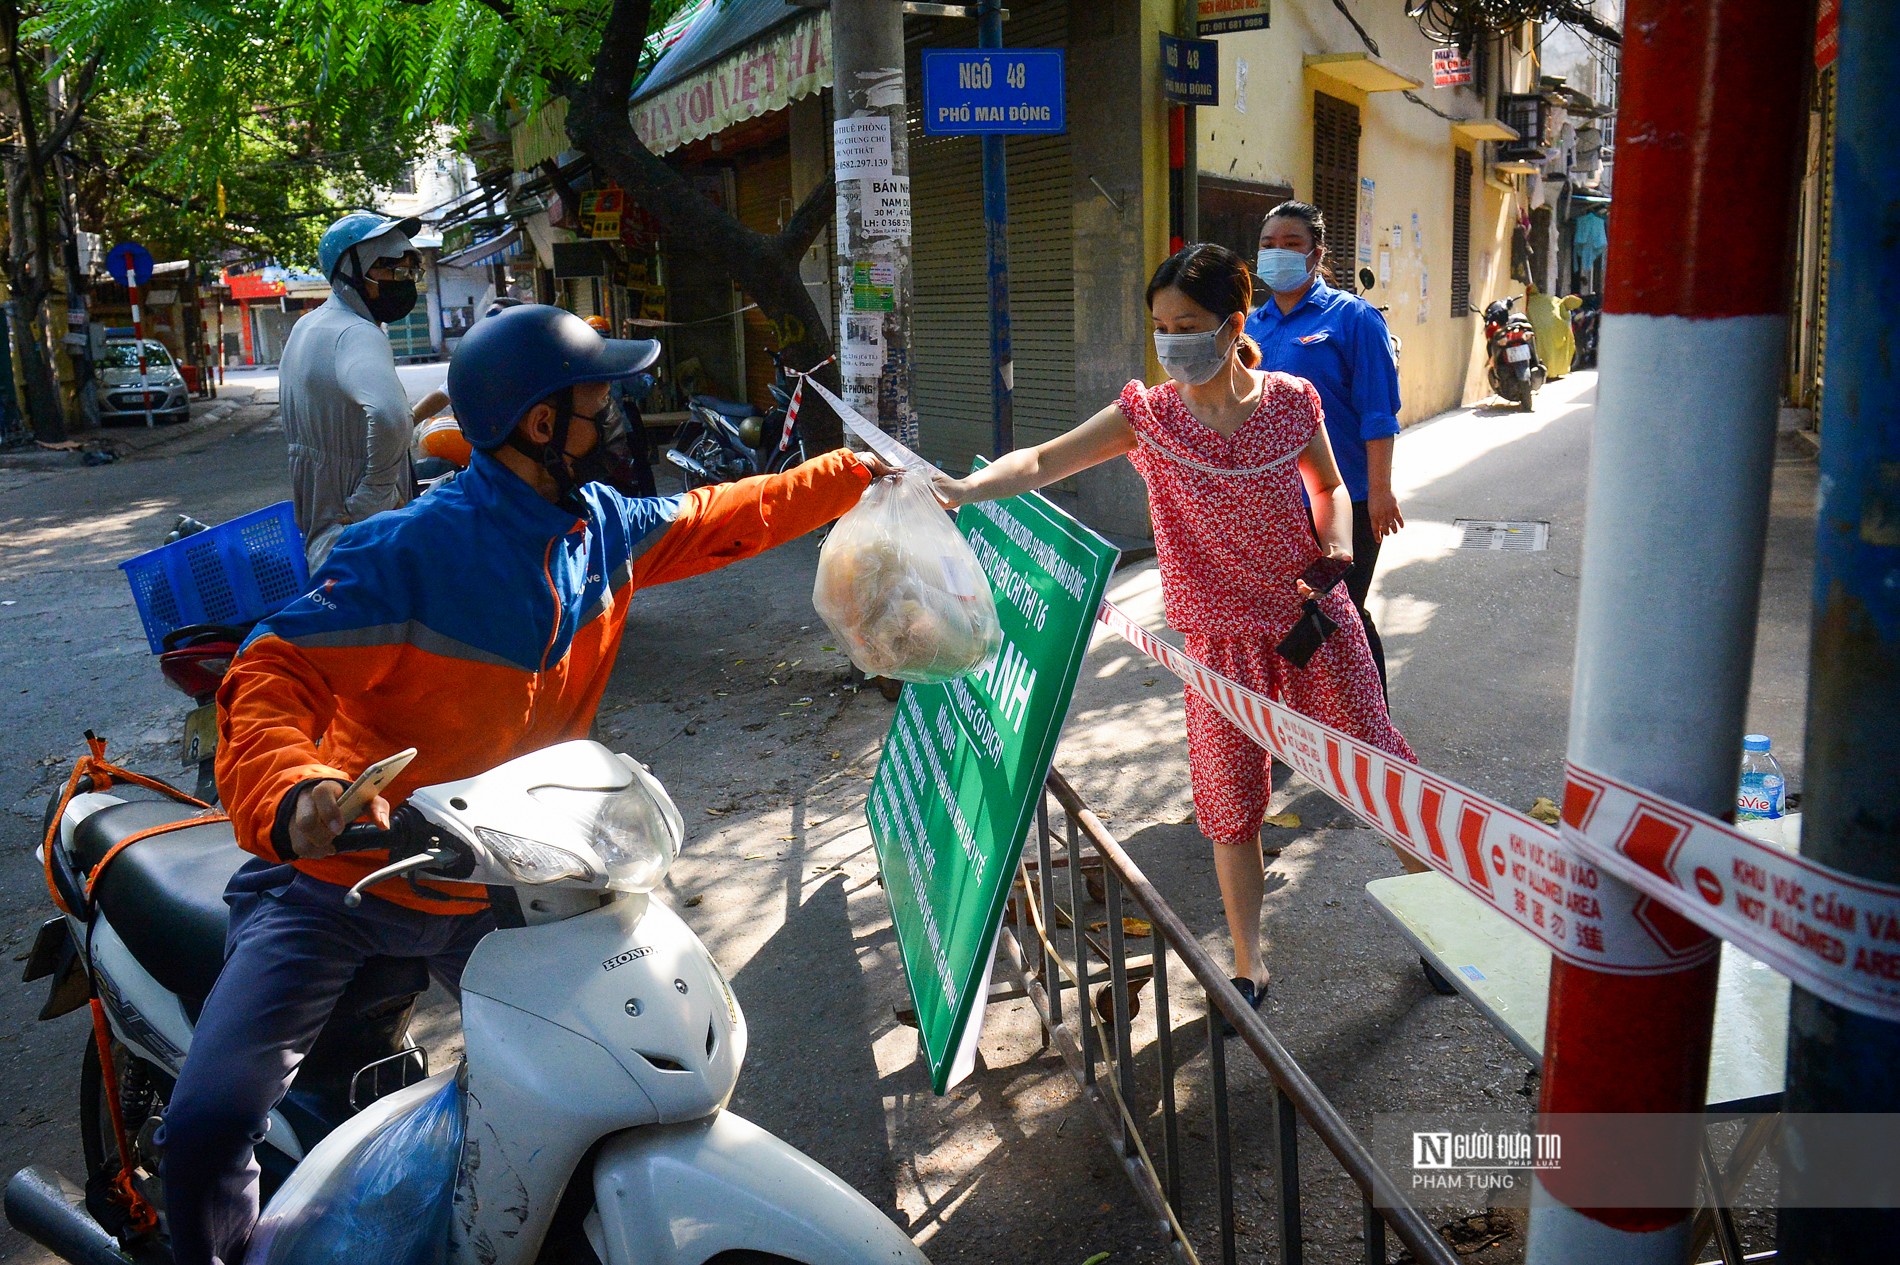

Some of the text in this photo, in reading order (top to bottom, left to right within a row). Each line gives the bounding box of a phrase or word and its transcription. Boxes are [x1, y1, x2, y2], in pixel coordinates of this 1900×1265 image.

[959, 57, 1025, 89] NGÕ 48
[1187, 50, 1199, 70] 48
[1190, 81, 1212, 97] ĐỘNG
[939, 101, 1050, 125] PHỐ MAI ĐỘNG
[845, 136, 869, 145] CHUNG
[873, 179, 897, 193] BÁN
[881, 199, 901, 207] NAM
[990, 556, 1012, 594] HIỆN
[1006, 572, 1028, 605] CHỈ
[1019, 583, 1038, 628] THỊ
[1034, 600, 1048, 631] 16
[1065, 565, 1087, 602] ĐỘNG
[973, 631, 1037, 734] ANH
[973, 707, 987, 736] CÓ
[953, 807, 967, 841] KHAI
[962, 827, 975, 860] BÁO
[1512, 861, 1526, 883] NOT
[1567, 891, 1603, 920] AREA
[1570, 862, 1599, 890] VÀO
[1732, 858, 1766, 892] KHU
[1812, 892, 1856, 932] CẤM
[1866, 909, 1900, 943] VÀ
[1735, 889, 1766, 925] NOT
